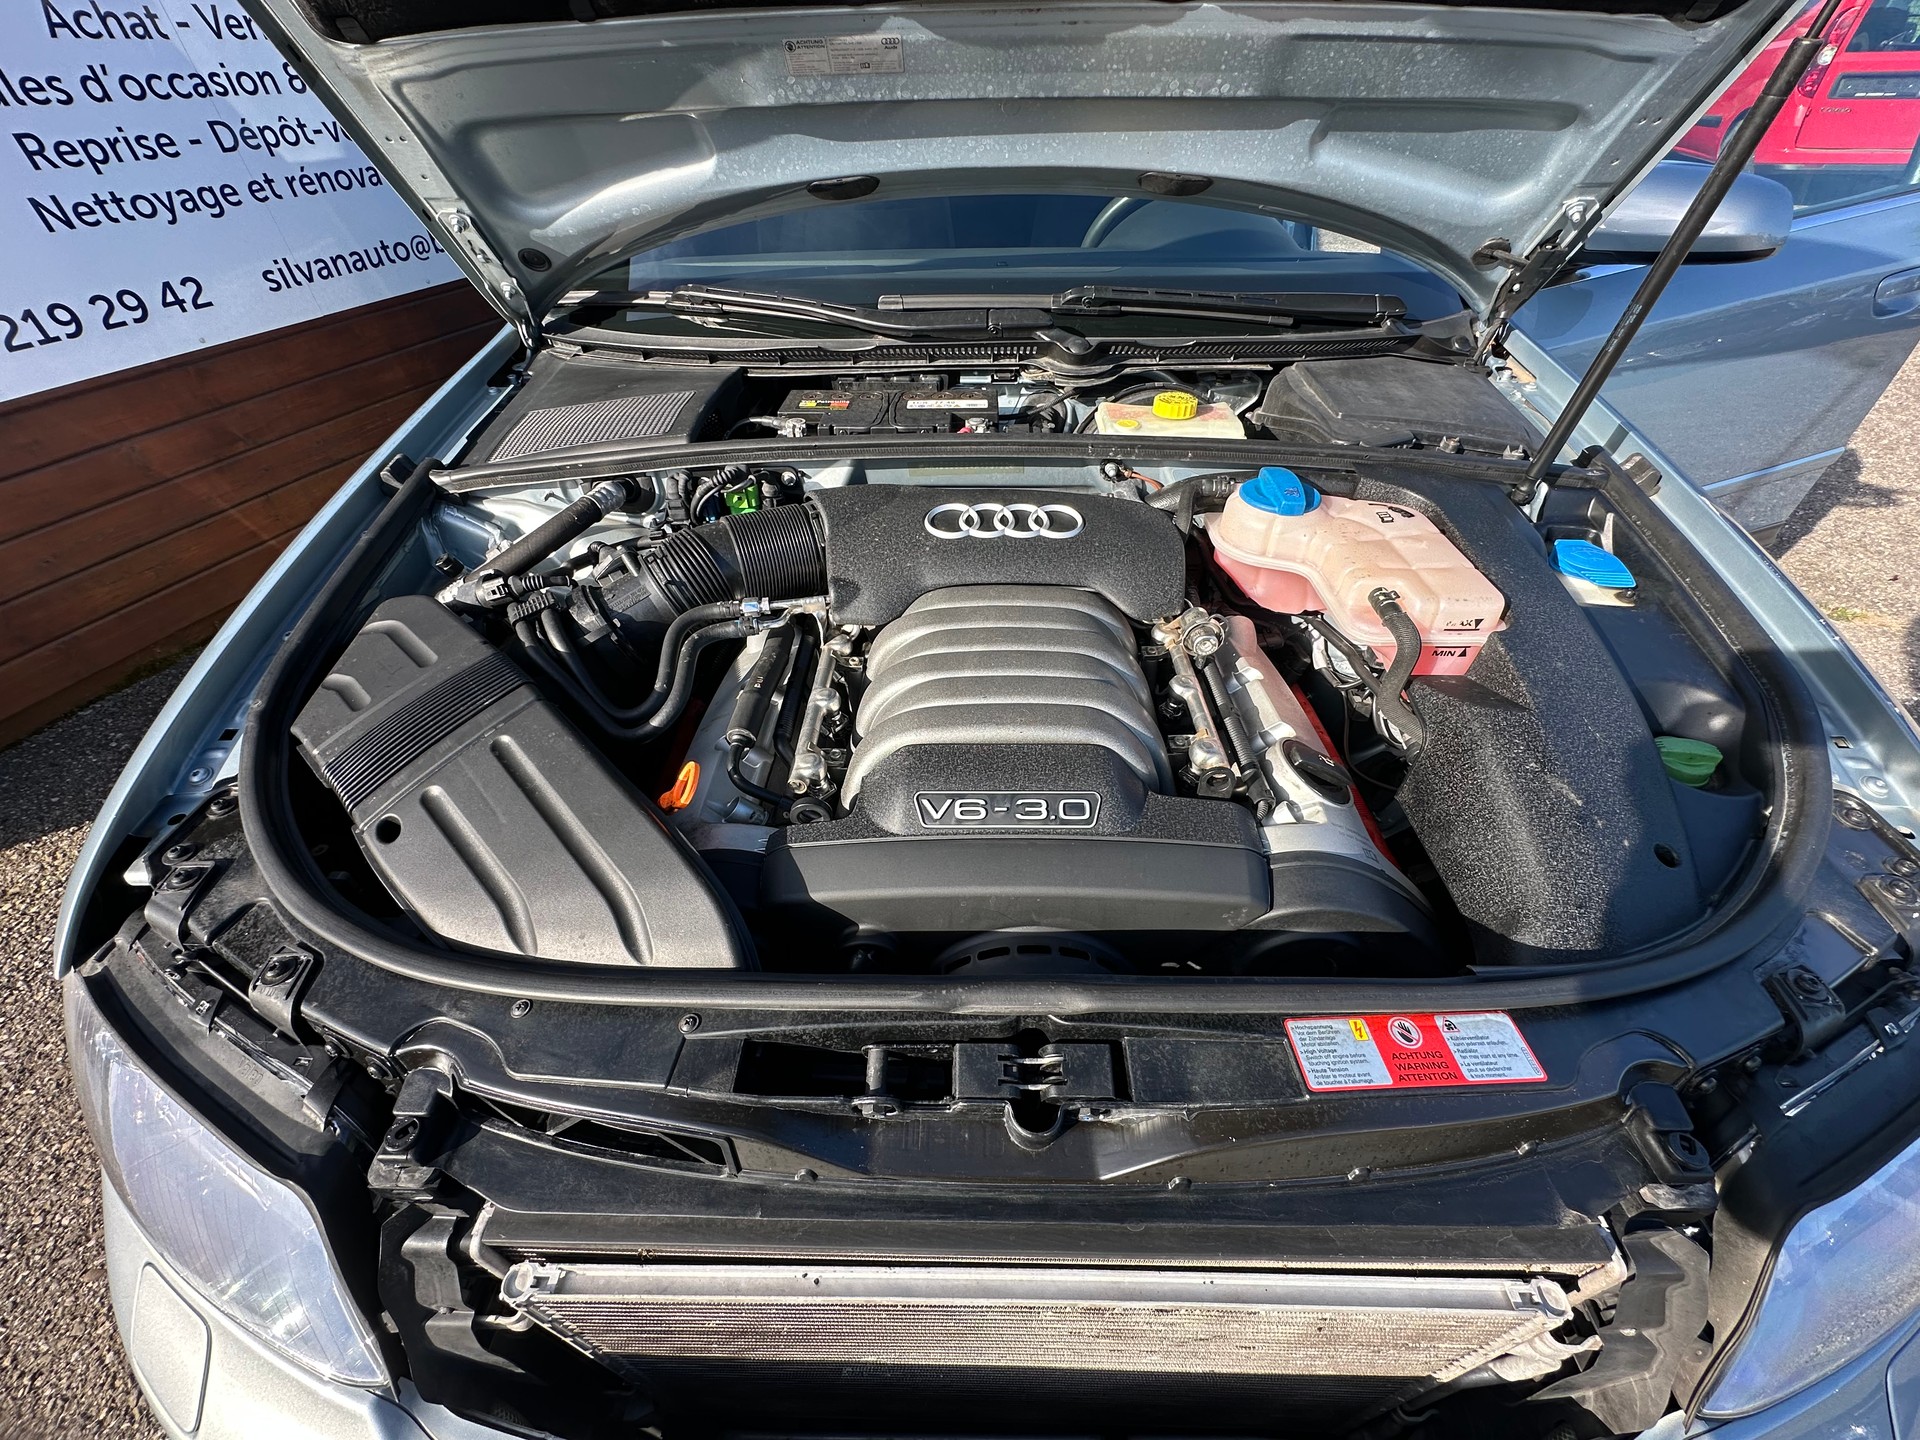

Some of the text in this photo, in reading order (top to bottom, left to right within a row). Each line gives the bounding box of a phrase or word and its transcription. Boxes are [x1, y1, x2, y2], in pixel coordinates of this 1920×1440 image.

[41, 0, 170, 40] Achat
[0, 68, 74, 106] les
[79, 62, 282, 103] d'occasion
[12, 126, 181, 175] Reprise
[27, 165, 383, 233] Nettoyage et rénova
[88, 288, 149, 331] 29
[161, 276, 214, 313] 42
[1392, 1050, 1443, 1060] ACHTUNG
[1394, 1061, 1449, 1071] WARNING
[1399, 1072, 1458, 1081] ATTENTION
